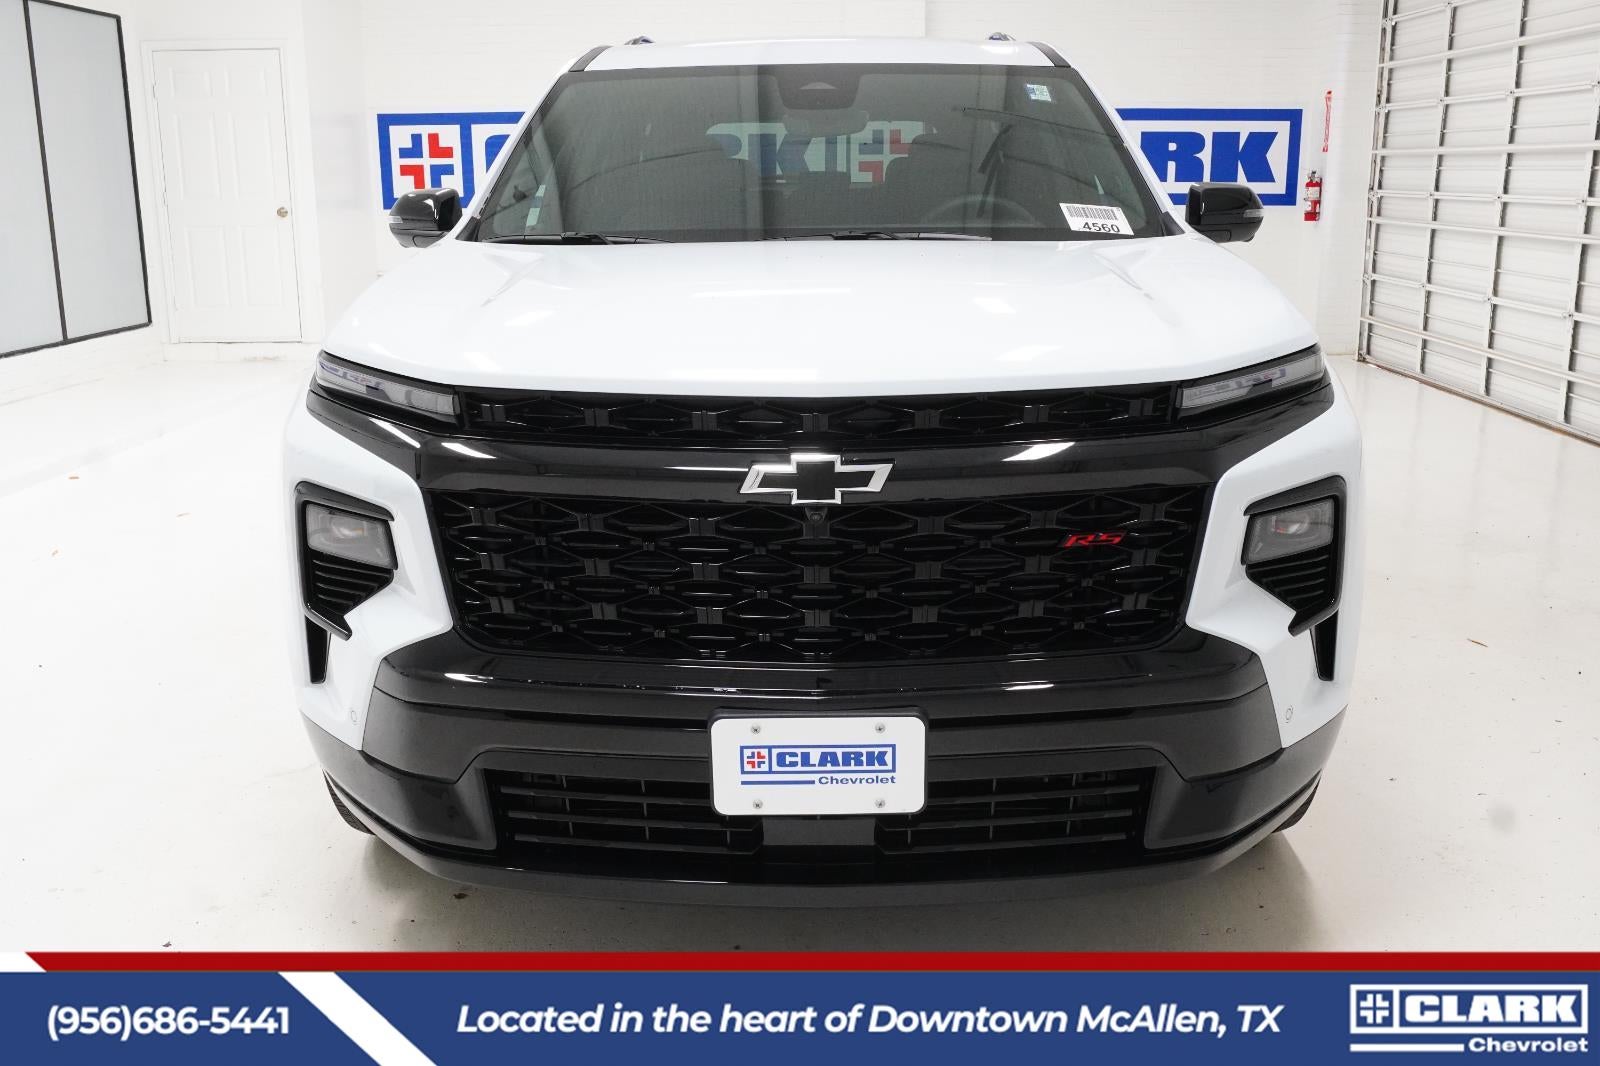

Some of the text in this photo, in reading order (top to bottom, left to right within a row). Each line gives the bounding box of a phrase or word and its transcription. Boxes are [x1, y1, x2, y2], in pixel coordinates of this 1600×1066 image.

[1082, 221, 1121, 233] 4560
[1063, 532, 1125, 548] RS
[776, 751, 889, 768] CLARK
[818, 775, 897, 785] Chevrolet
